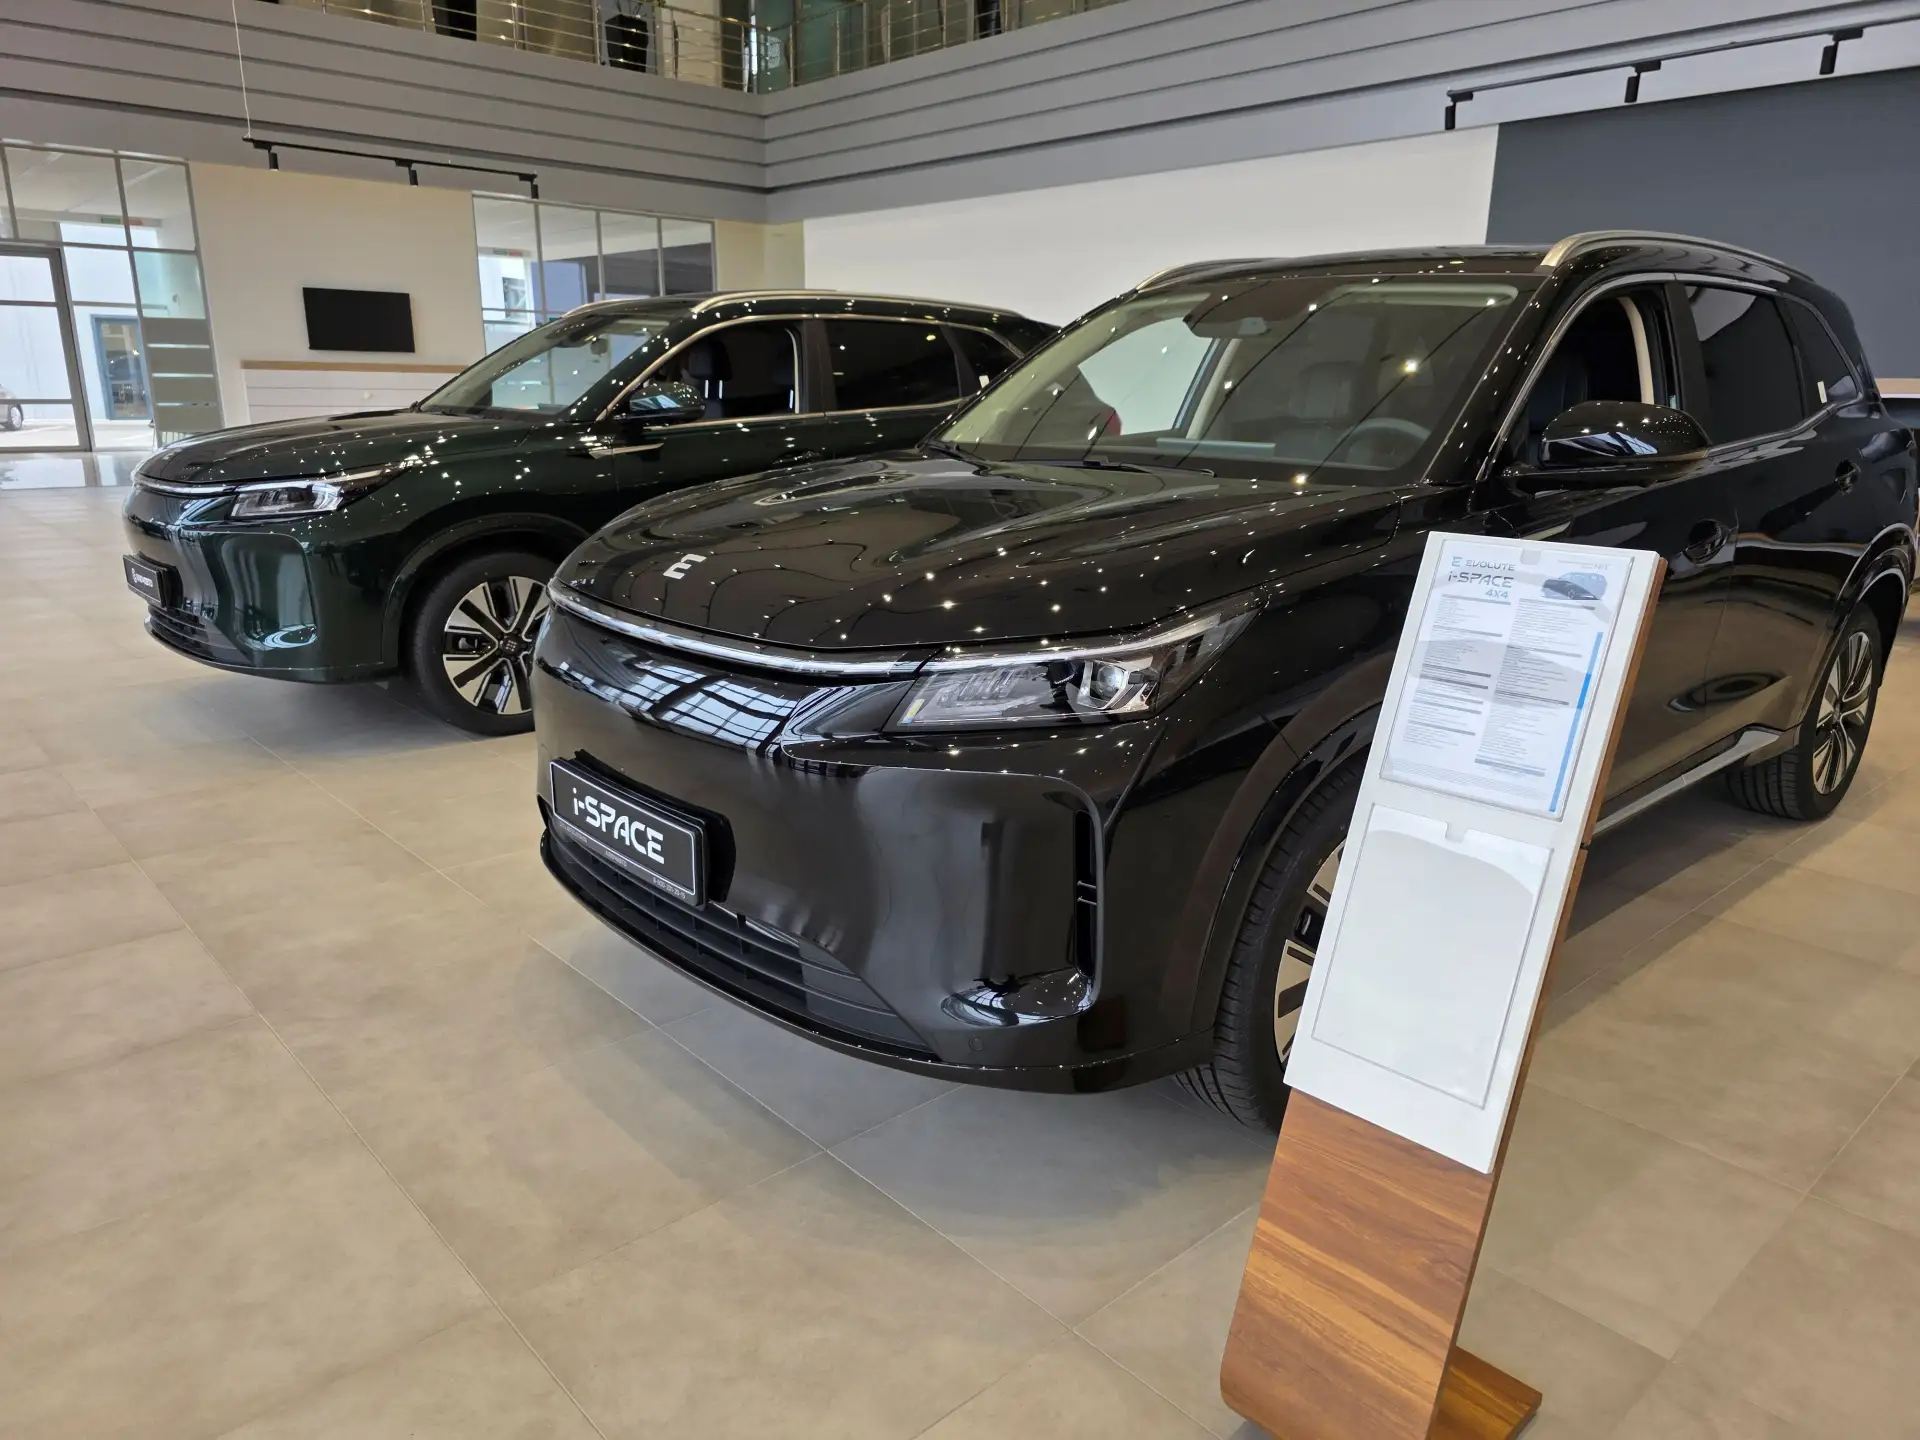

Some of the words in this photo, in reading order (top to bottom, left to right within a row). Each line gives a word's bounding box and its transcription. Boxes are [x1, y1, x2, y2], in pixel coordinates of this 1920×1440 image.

[1466, 560, 1515, 571] EVOLUTE
[1448, 571, 1514, 588] i-SPACE
[572, 787, 665, 865] i-SPACE
